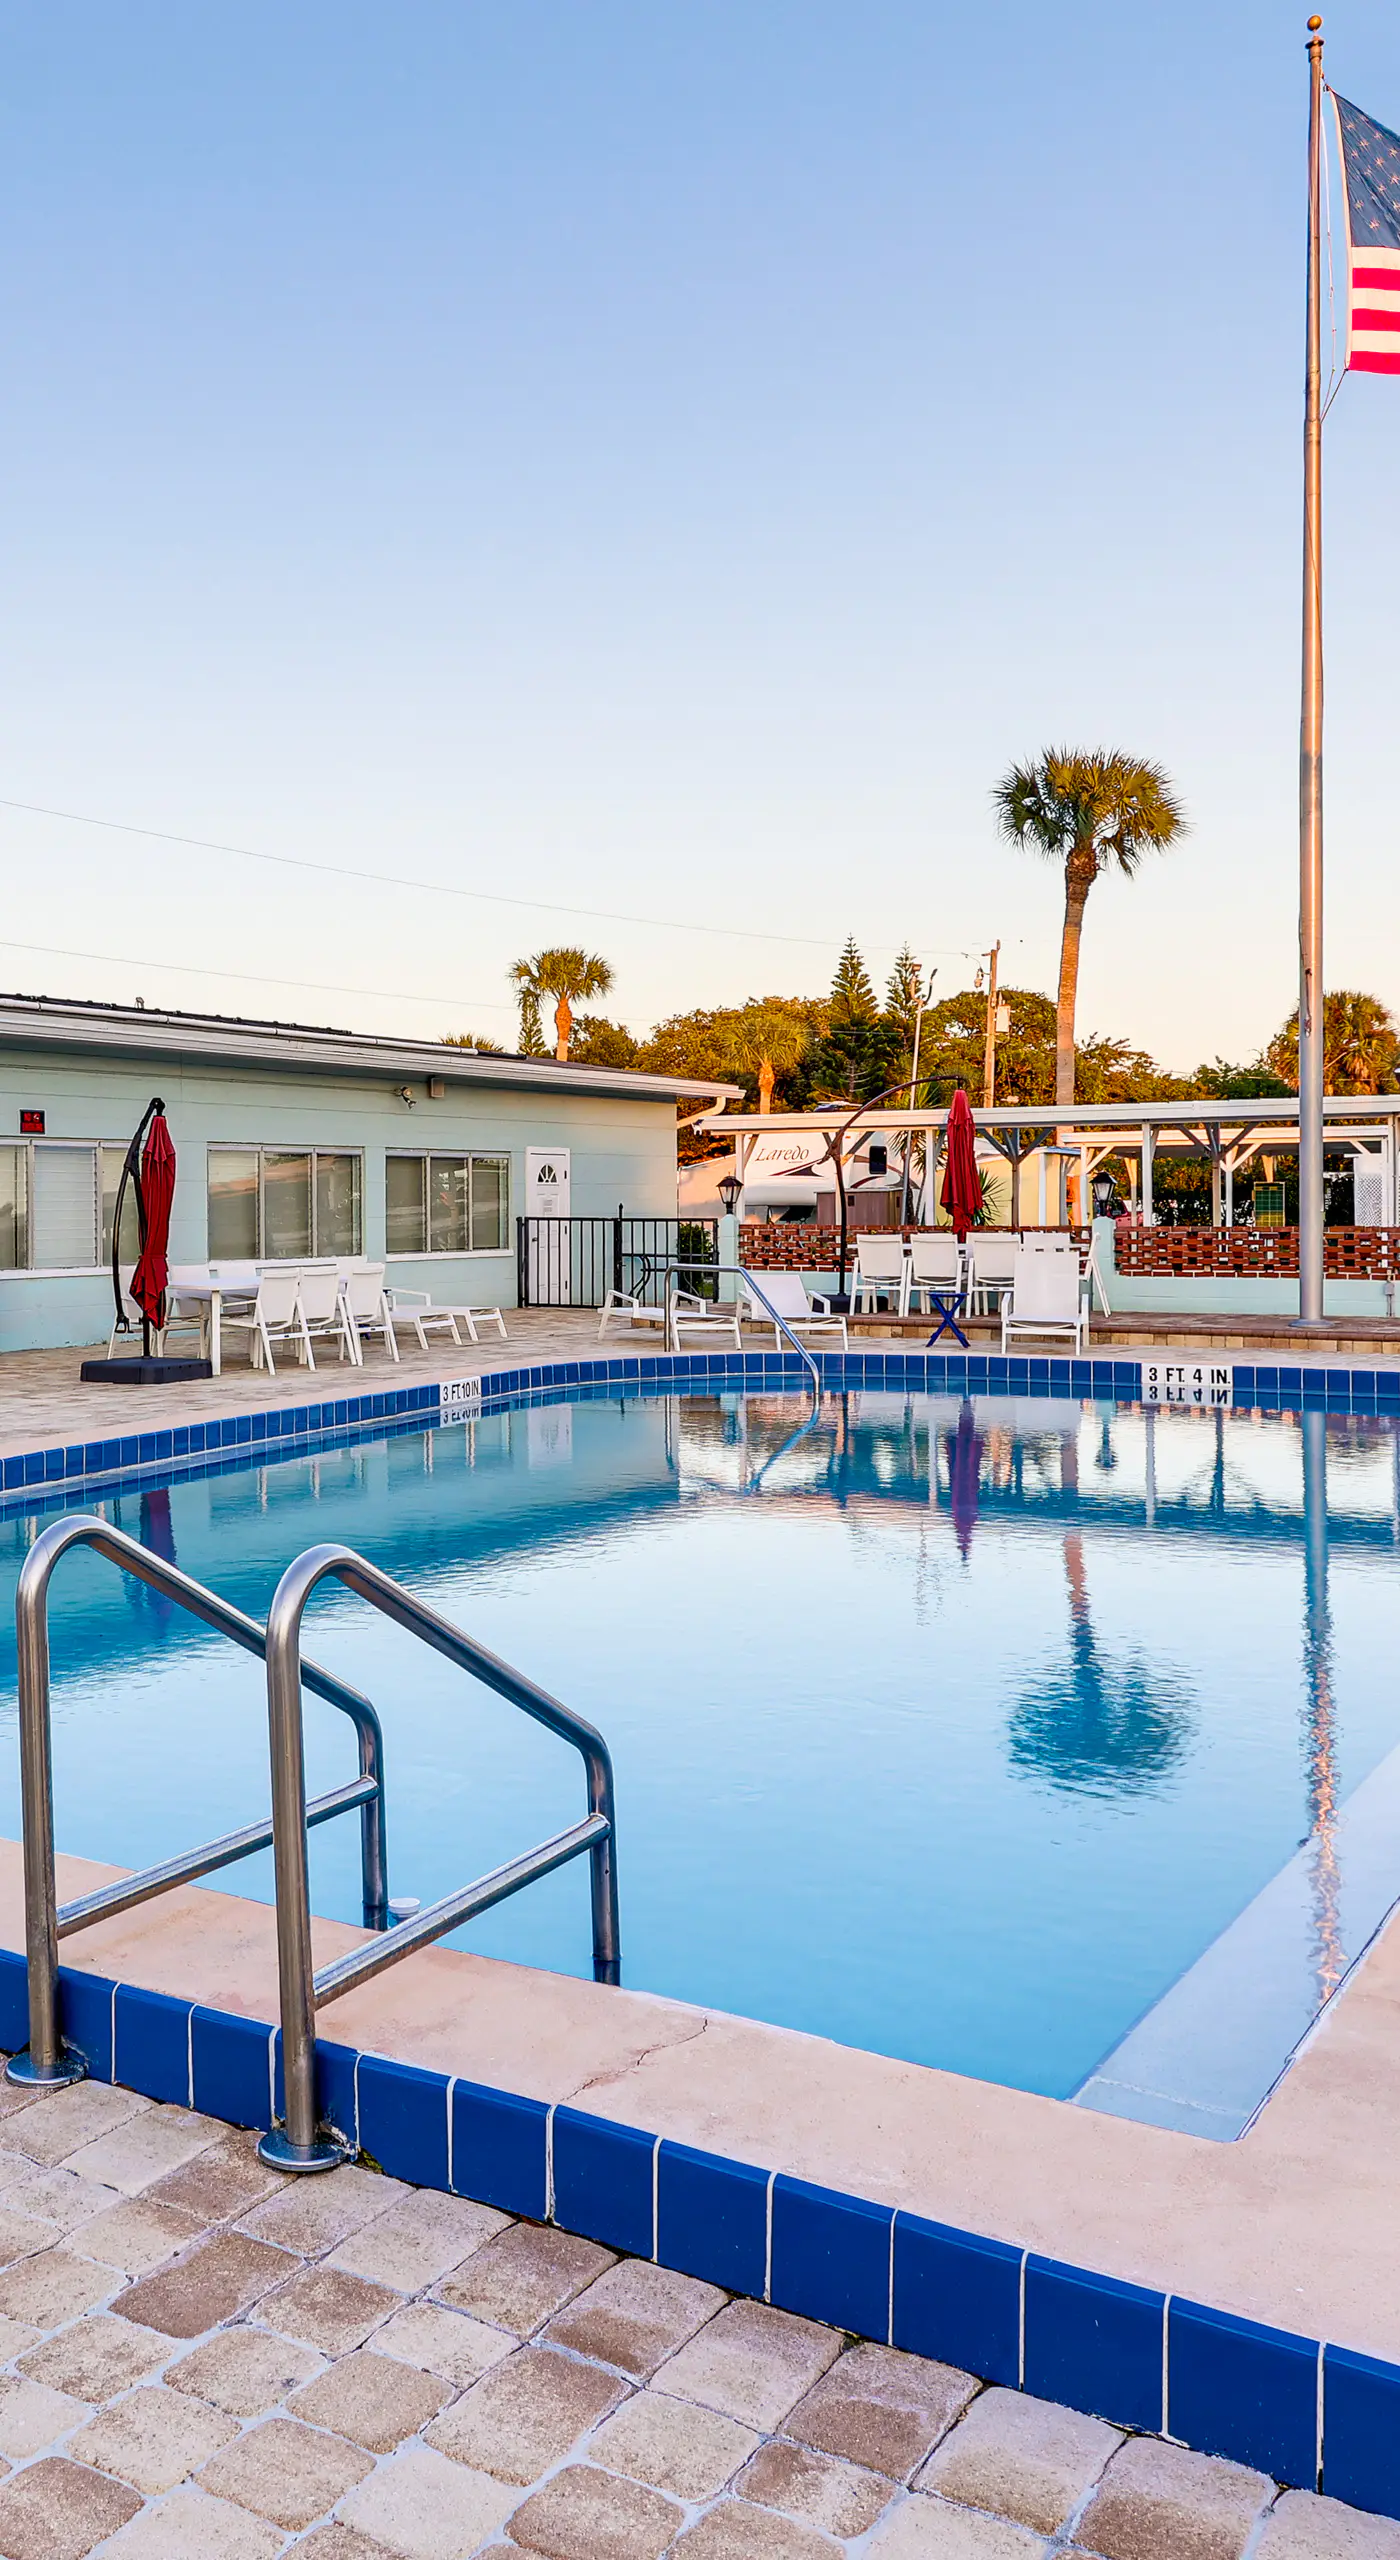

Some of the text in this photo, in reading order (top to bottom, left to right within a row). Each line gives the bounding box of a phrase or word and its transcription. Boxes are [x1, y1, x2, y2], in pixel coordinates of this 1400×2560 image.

[755, 1145, 810, 1162] Laredo
[1149, 1367, 1231, 1384] 3 FT. 4 IN.
[443, 1385, 449, 1402] 3
[461, 1381, 471, 1399] 10
[471, 1379, 481, 1396] IN.
